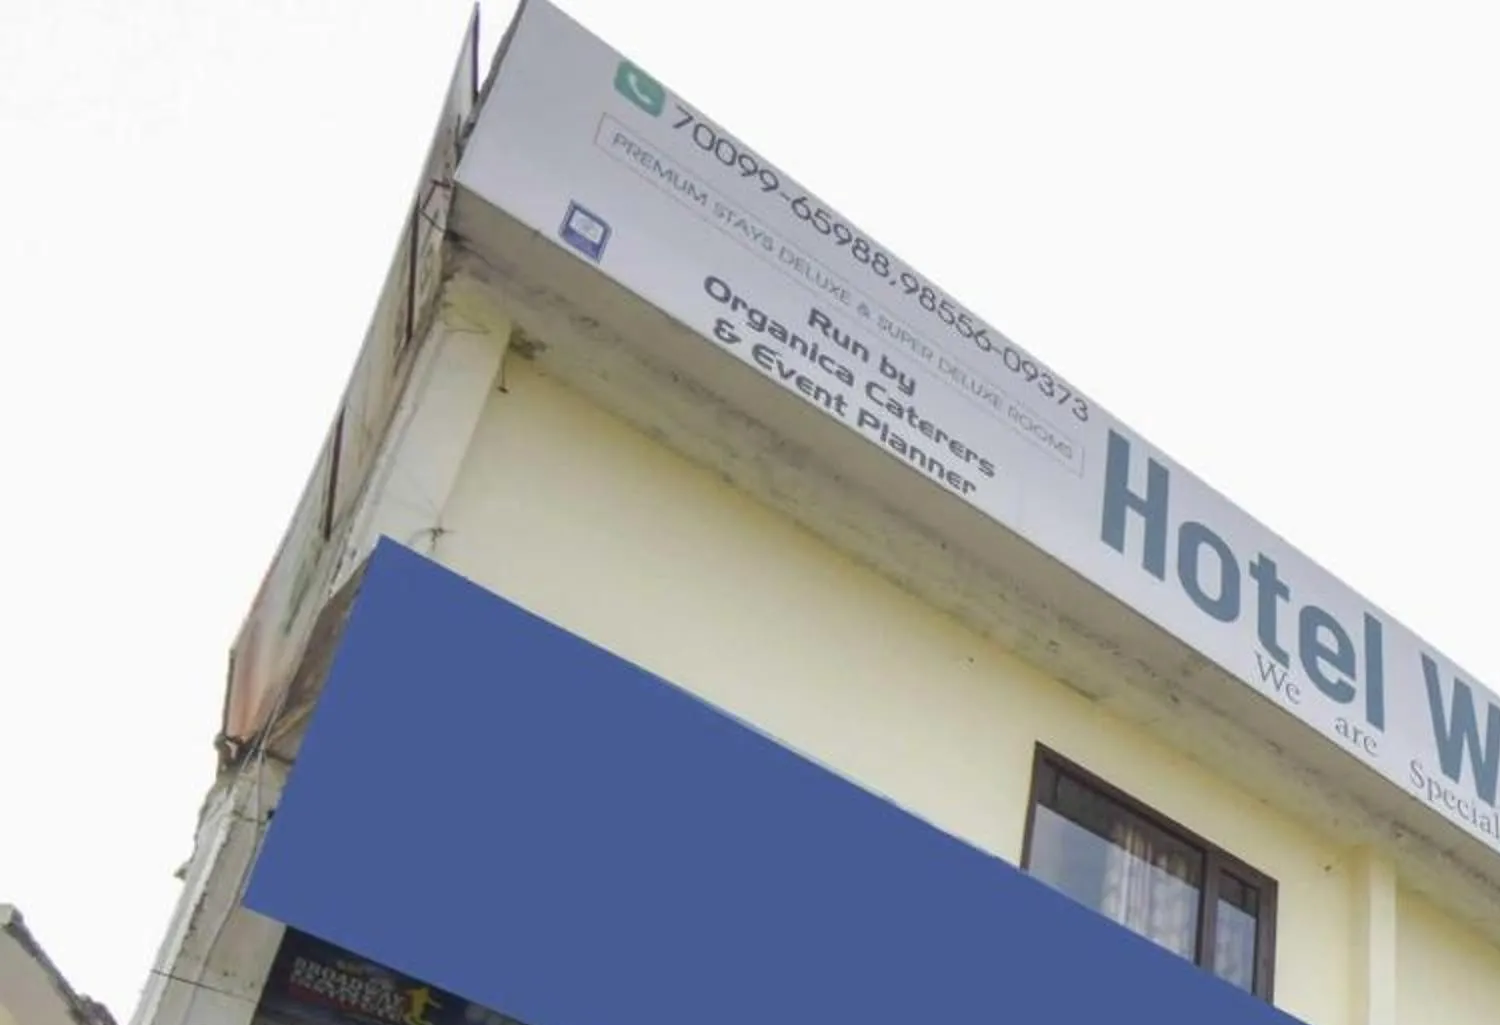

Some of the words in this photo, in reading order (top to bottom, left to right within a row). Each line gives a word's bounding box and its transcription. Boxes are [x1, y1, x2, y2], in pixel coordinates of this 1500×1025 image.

[704, 275, 855, 387] Organica
[865, 381, 995, 478] Caterers
[712, 317, 741, 345] &
[753, 342, 848, 416] Event
[857, 407, 976, 495] Planner
[713, 201, 775, 252] STAYS
[778, 246, 850, 306] DELUXE
[877, 314, 933, 362] SUPER
[938, 356, 1002, 407] DELUXE
[1007, 405, 1073, 460] ROOMS
[809, 307, 870, 363] Run
[879, 356, 916, 396] by
[1100, 428, 1385, 734] Hotel
[1255, 651, 1302, 705] We
[1334, 717, 1379, 756] are
